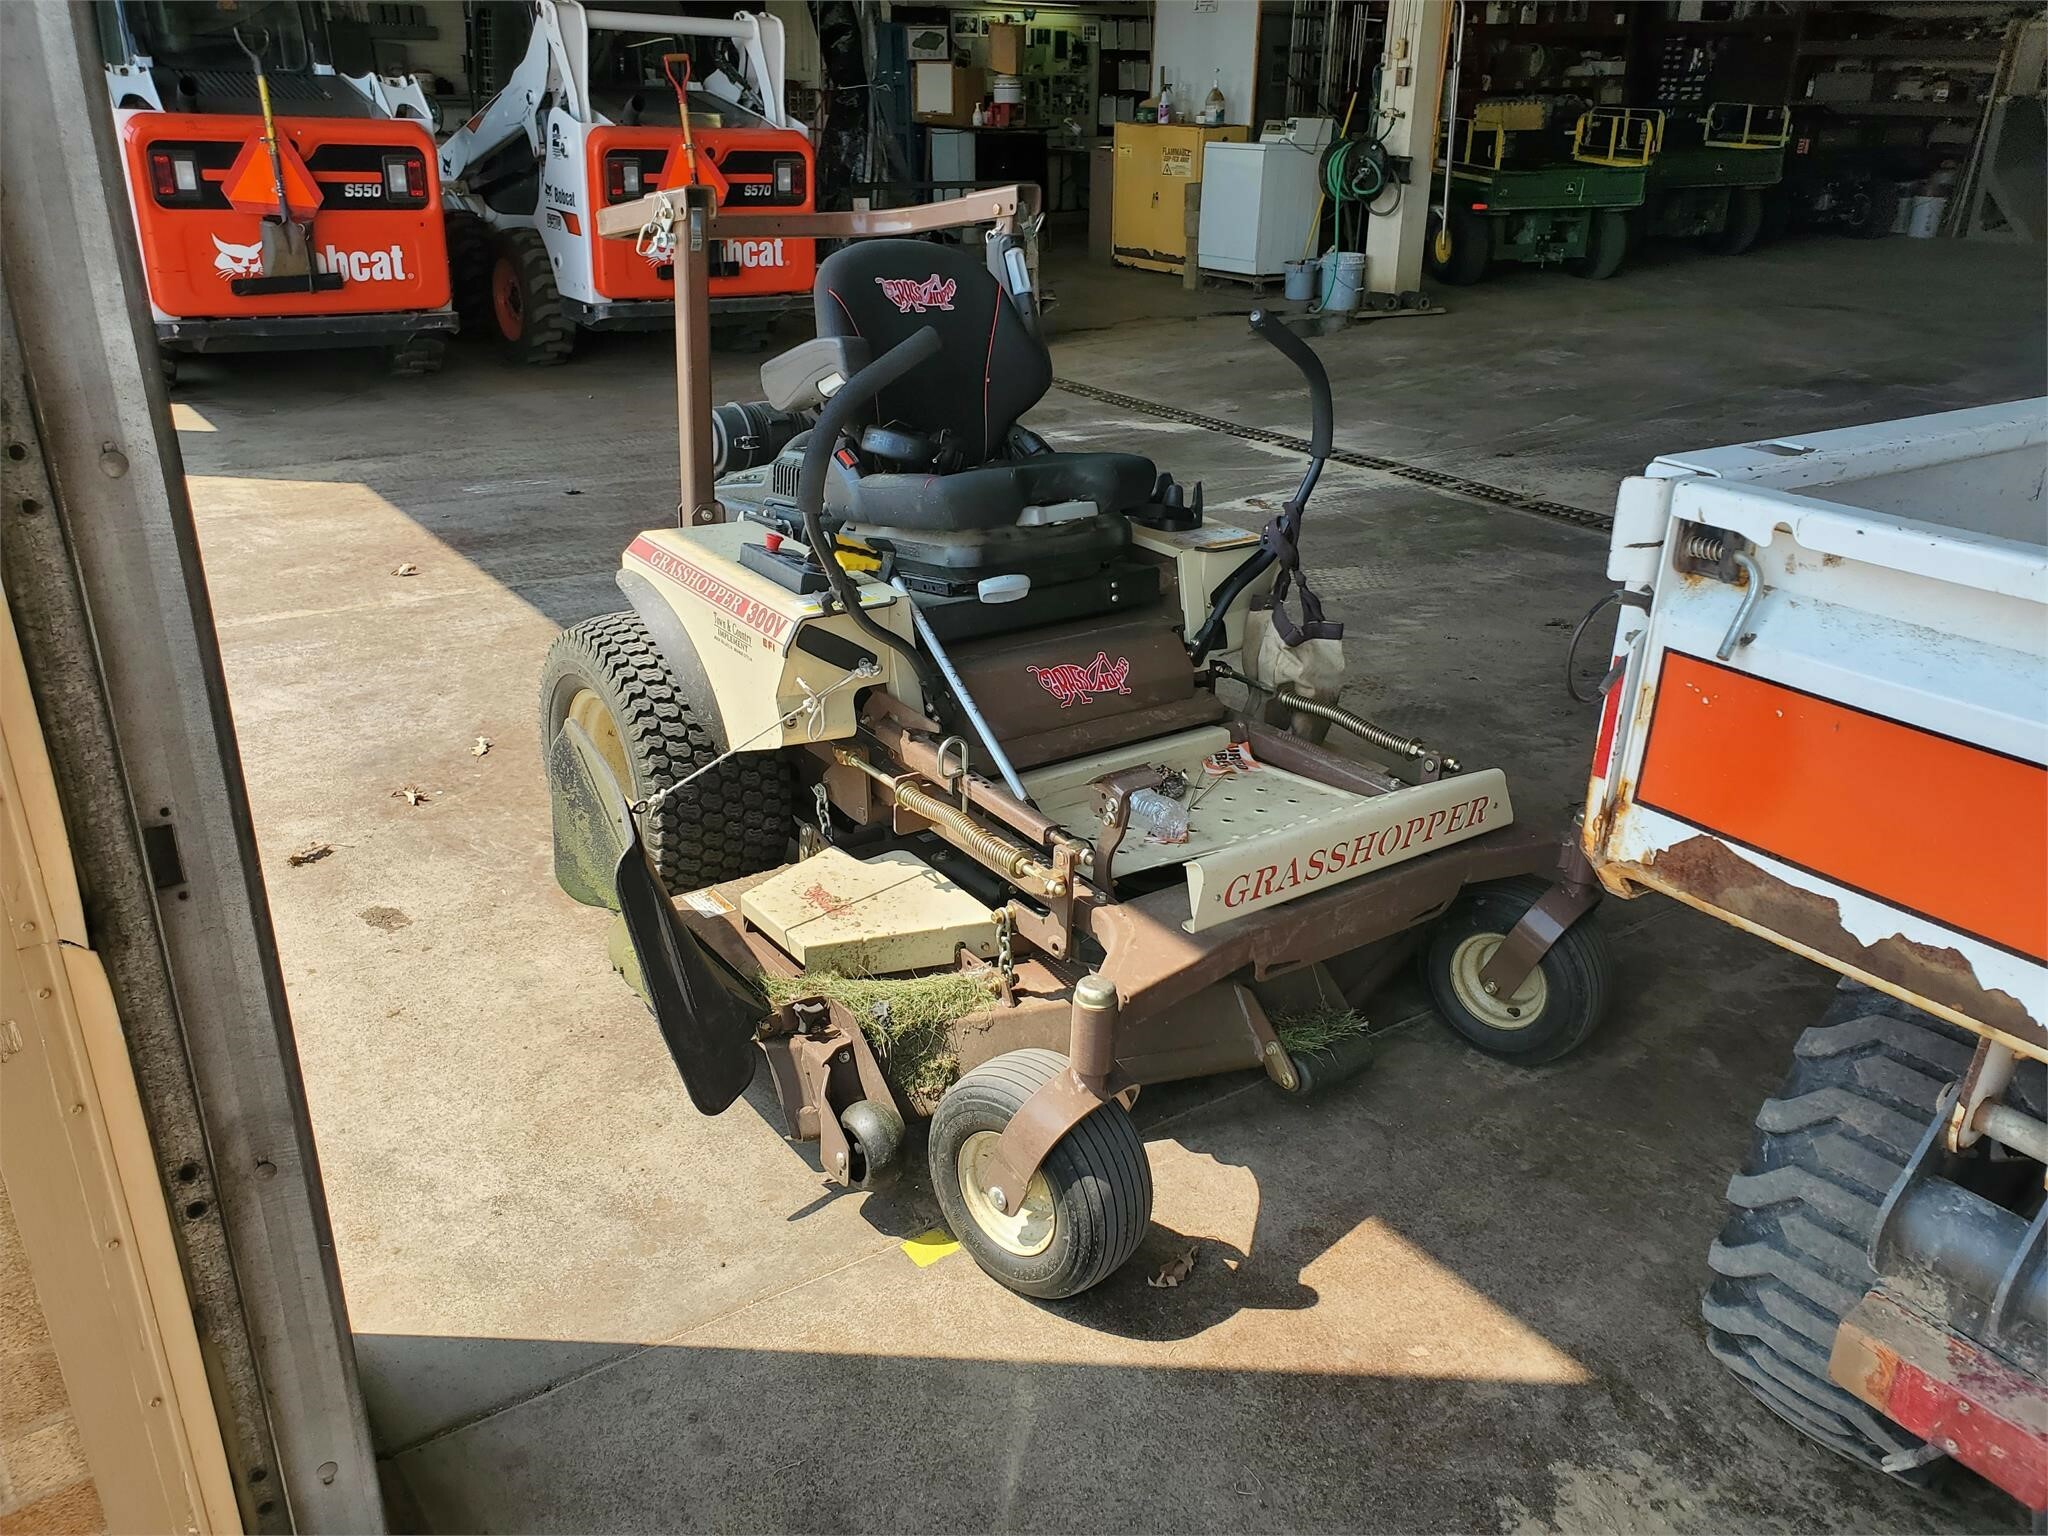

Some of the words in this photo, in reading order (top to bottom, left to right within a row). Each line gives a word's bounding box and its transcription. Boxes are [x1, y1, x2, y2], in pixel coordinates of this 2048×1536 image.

[344, 183, 382, 198] S550
[743, 184, 772, 197] S570
[315, 244, 406, 282] bcat
[722, 238, 784, 268] bcat
[650, 550, 743, 616] GRASSHOPPER
[746, 603, 789, 639] 300V
[762, 637, 776, 652] EFI
[1224, 796, 1489, 908] GRASSHOPPER
